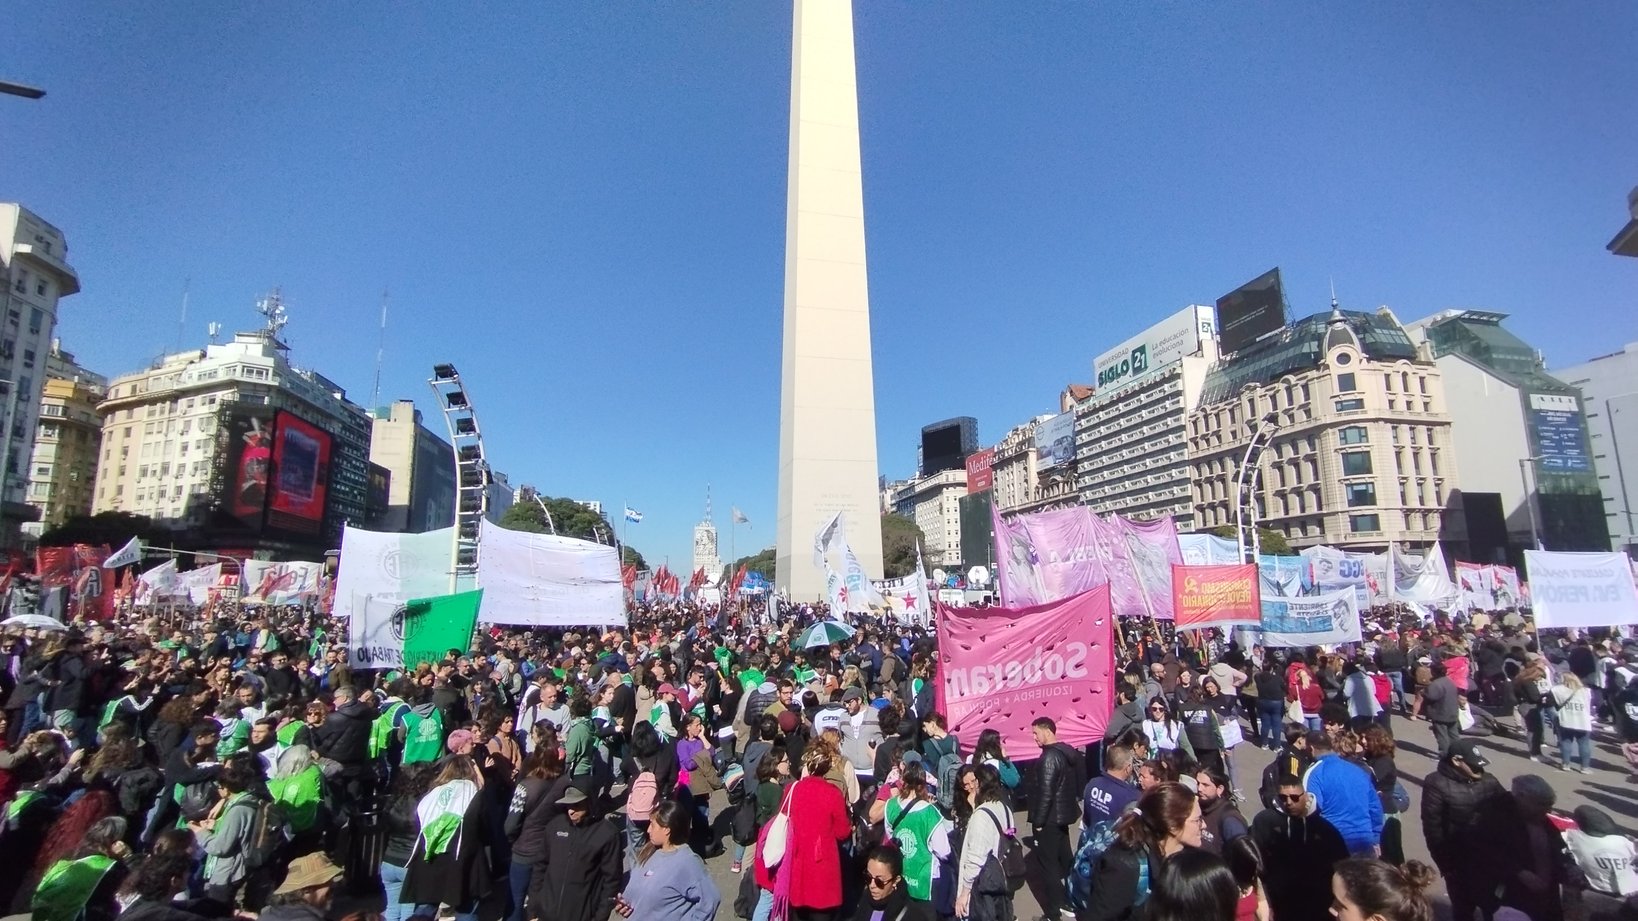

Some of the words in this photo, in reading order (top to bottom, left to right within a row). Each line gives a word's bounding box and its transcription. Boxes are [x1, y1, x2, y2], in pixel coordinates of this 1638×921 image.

[1151, 342, 1159, 351] La
[1158, 327, 1190, 348] educación
[1098, 347, 1130, 369] UNIVERSIDAD
[1152, 340, 1184, 360] evoluciona
[1097, 358, 1131, 388] SIGLO
[1091, 787, 1113, 805] OLP
[1594, 857, 1628, 870] UTEP
